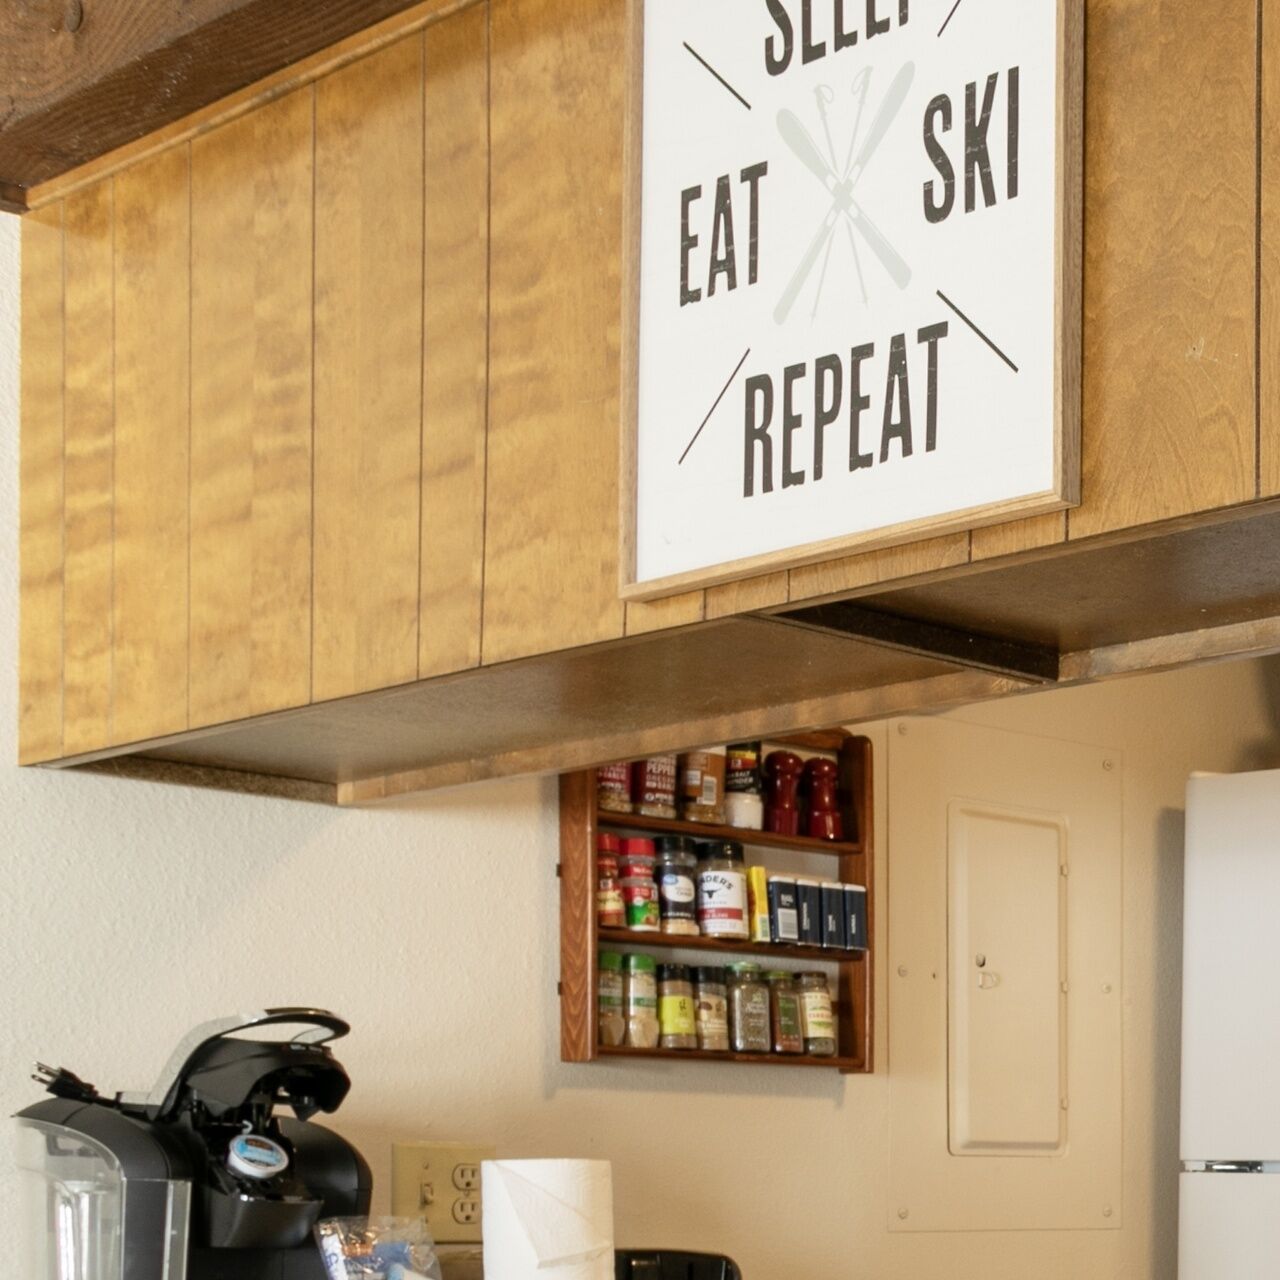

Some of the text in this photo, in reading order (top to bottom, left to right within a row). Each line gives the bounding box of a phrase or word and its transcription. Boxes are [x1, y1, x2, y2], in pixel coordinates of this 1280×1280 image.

[922, 66, 1020, 224] SKI
[679, 161, 768, 308] EAT
[743, 320, 948, 498] REPEAT
